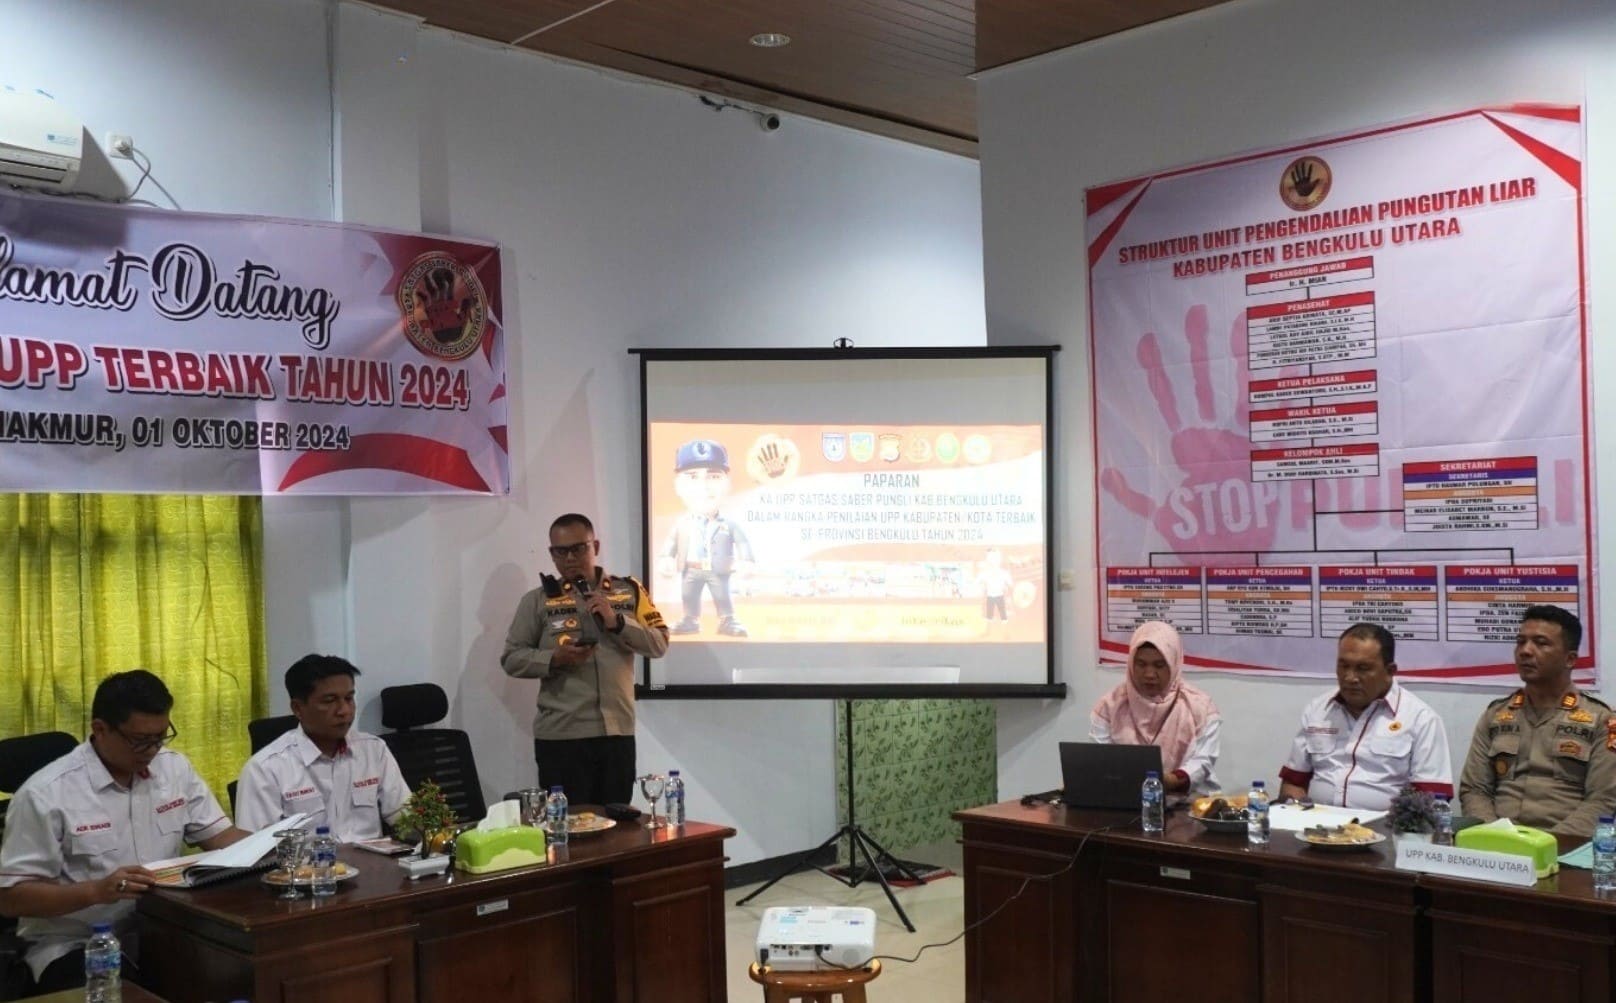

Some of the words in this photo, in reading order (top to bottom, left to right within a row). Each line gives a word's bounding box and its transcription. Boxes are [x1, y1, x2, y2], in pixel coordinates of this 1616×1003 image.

[1119, 235, 1199, 264] STRUKTUR
[1203, 227, 1241, 249] UNIT
[1245, 203, 1373, 243] PENGENDALIAN
[1378, 185, 1484, 221] PUNGUTAN
[1490, 176, 1536, 203] LIAR
[1173, 246, 1275, 278] KABUPATEN
[1282, 229, 1383, 261] BENGKULU
[1391, 217, 1461, 244] UTARA
[1270, 266, 1319, 280] PENANGGUNG
[1320, 262, 1347, 273] JAWAB
[151, 243, 340, 350] Datang
[1287, 300, 1330, 312] PENASEHAT
[0, 336, 86, 388] UPP
[93, 345, 275, 398] TERBAIK
[279, 355, 393, 405] TAHUN
[400, 363, 469, 408] 2024
[1277, 380, 1301, 389] KETUA
[1302, 375, 1345, 387] PELAKSANA
[1287, 408, 1311, 417] WAKIL
[1312, 407, 1336, 416] KETUA
[132, 416, 163, 447] 01
[172, 417, 291, 449] OKTOBER
[296, 423, 349, 450] 2024
[1283, 448, 1322, 458] KELOMPOK
[1324, 446, 1343, 456] AHLI
[1440, 461, 1497, 472] SEKRETARIAT
[863, 473, 920, 489] PAPARAN
[1448, 472, 1489, 480] SEKRETARIS
[799, 493, 838, 506] SATGAS
[841, 493, 873, 506] SABER
[991, 492, 1022, 506] UTARA
[1168, 475, 1274, 540] STOP
[747, 510, 781, 522] DALAM
[827, 511, 878, 523] PENILAIAN
[880, 511, 900, 524] UPP
[995, 511, 1036, 524] TERBAIK
[867, 527, 919, 541] BENGKULU
[921, 527, 955, 541] TAHUN
[958, 527, 984, 541] 2024
[1117, 568, 1138, 576] POKJA
[1139, 568, 1154, 576] UNIT
[1214, 568, 1236, 576] POKJA
[1236, 568, 1254, 576] UNIT
[1256, 568, 1303, 576] PENCEGAHAN
[1338, 568, 1364, 576] POKJA
[1365, 568, 1385, 576] UNIT
[1386, 568, 1415, 576] TINDAK
[1464, 567, 1492, 576] POKJA
[1494, 567, 1514, 576] UNIT
[1515, 567, 1557, 576] YUSTISIA
[1556, 724, 1595, 741] POLRI
[1405, 849, 1424, 859] UPP
[1425, 852, 1445, 863] KAB.
[1448, 854, 1497, 869] BENGKULU
[1498, 861, 1529, 873] UTARA
